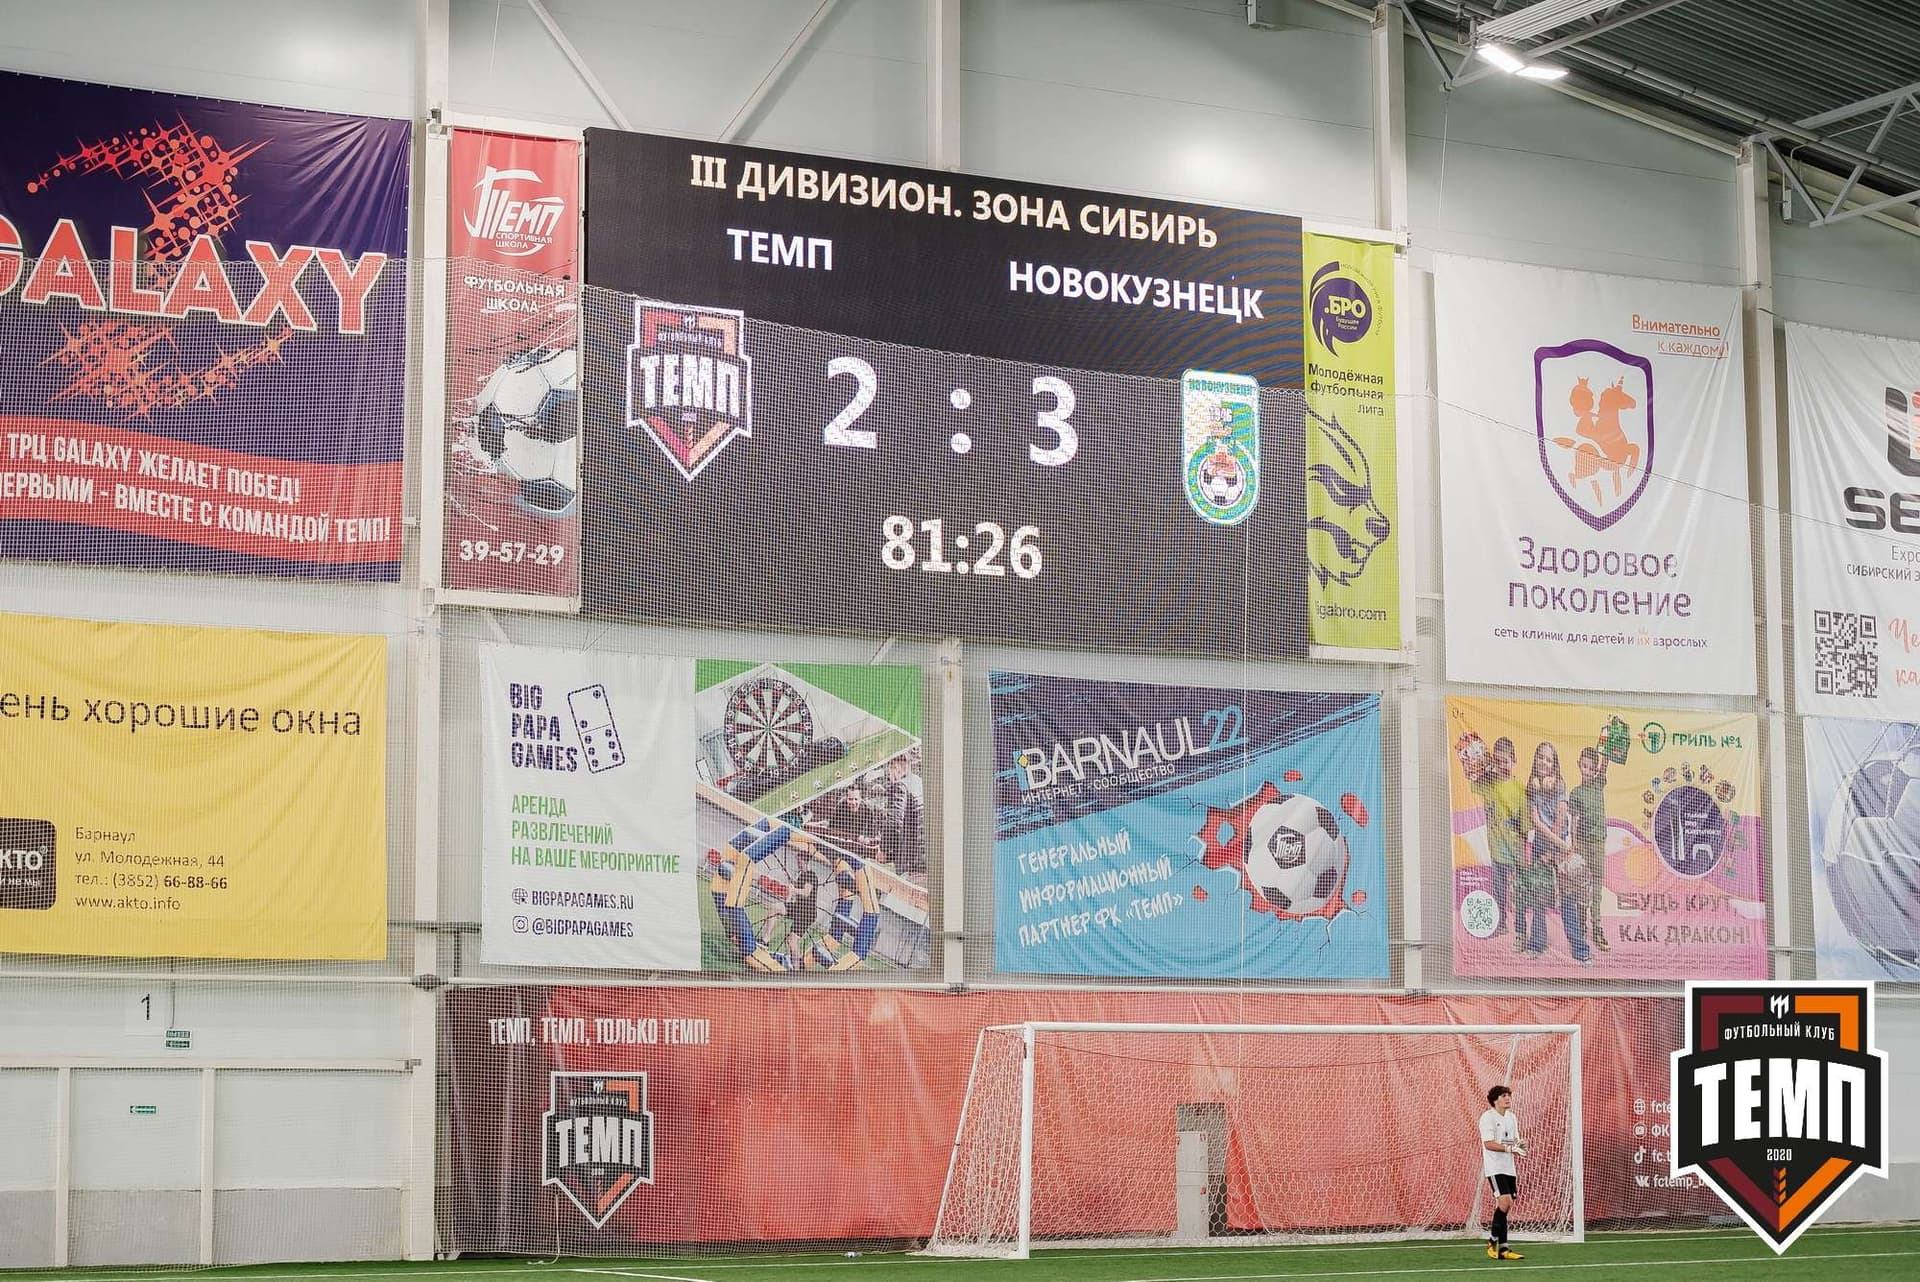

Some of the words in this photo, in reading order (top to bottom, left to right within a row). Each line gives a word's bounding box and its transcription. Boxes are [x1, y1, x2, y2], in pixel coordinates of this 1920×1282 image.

[463, 166, 565, 239] ТЕМП
[736, 161, 962, 218] ДИВИЗИОН.
[973, 190, 1070, 231] ЗОНА
[1080, 204, 1218, 249] СИБИРЬ
[495, 233, 553, 244] СПОРТИВНАЯ
[495, 240, 529, 249] ШКОЛА
[727, 228, 833, 271] ТЕМП
[464, 275, 565, 297] ФУТБОЛЬНАЯ
[1009, 261, 1265, 323] НОВОКУЗНЕЦК
[487, 297, 539, 313] ШКОЛА
[1632, 314, 1720, 337] Внимательно
[640, 353, 740, 418] ТЕМП
[1308, 363, 1384, 385] Молодёжная
[1310, 381, 1384, 401] футбольная
[824, 356, 878, 449] 2
[1029, 376, 1079, 467] 3
[1357, 404, 1384, 417] лига
[7, 433, 47, 463] ТРЦ
[53, 436, 132, 472] GALAXY
[138, 450, 221, 490] ЖЕЛАЕТ
[227, 468, 300, 503] ПОБЕД!
[0, 472, 93, 504] ЕРВЫМИ
[115, 484, 194, 524] ВМЕСТЕ
[199, 504, 213, 526] С
[219, 504, 329, 543] КОМАНДОЙ
[335, 516, 391, 543] ТЕМП!
[460, 540, 565, 565] 39-57-29
[881, 515, 1043, 579] 81:26
[1519, 536, 1678, 578] Здоровое
[1846, 564, 1911, 581] СИБИРСКИЙ
[1508, 582, 1692, 618] поколение
[1494, 627, 1519, 639] сеть
[1522, 629, 1564, 642] клиник
[1566, 632, 1588, 644] для
[1590, 632, 1625, 645] детей
[1627, 635, 1634, 645] и
[1653, 637, 1708, 650] взрослых
[509, 683, 543, 710] BIG
[84, 698, 260, 733] хорошие
[271, 708, 361, 736] окна
[511, 712, 561, 742] PAPA
[1672, 732, 1717, 748] ГРИЛЬ
[1721, 735, 1743, 749] №1
[511, 741, 578, 772] GAMES
[511, 794, 567, 818] АРЕНДА
[75, 827, 136, 844] Барнаул
[511, 819, 614, 845] РАЗВЛЕЧЕНИЙ
[75, 851, 94, 864] ул.
[101, 850, 203, 868] Молодежная,
[207, 855, 225, 868] 44
[511, 845, 531, 866] НА
[535, 847, 577, 868] ВАШЕ
[580, 850, 680, 874] МЕРОПРИЯТИЕ
[1018, 827, 1131, 875] ГЕНЕРАЛЬНЫЙ
[75, 874, 108, 886] тел.:
[112, 872, 159, 889] (3852)
[164, 875, 228, 890] 66-88-66
[1019, 853, 1173, 913] ИНФОРМАЦИОННЫЙ
[75, 895, 181, 911] www.akto.info
[532, 890, 634, 910] BIGPAPAGAMES.RU
[1617, 892, 1680, 914] БУДЬ
[532, 917, 634, 938] @BIGPAPAGAMES
[1018, 912, 1091, 948] ПАРТНЕР
[1095, 904, 1122, 929] ФК
[1126, 891, 1184, 921] «ТЕМП»
[1619, 924, 1660, 943] КАК
[1664, 924, 1751, 946] ДРАКОН!
[141, 994, 150, 1021] 1
[488, 1017, 536, 1047] ТЕМП,
[541, 1017, 591, 1047] ТЕМП,
[594, 1017, 658, 1045] ТОЛЬКО
[663, 1018, 711, 1045] ТЕМП!
[555, 1116, 642, 1169] ТЕМП
